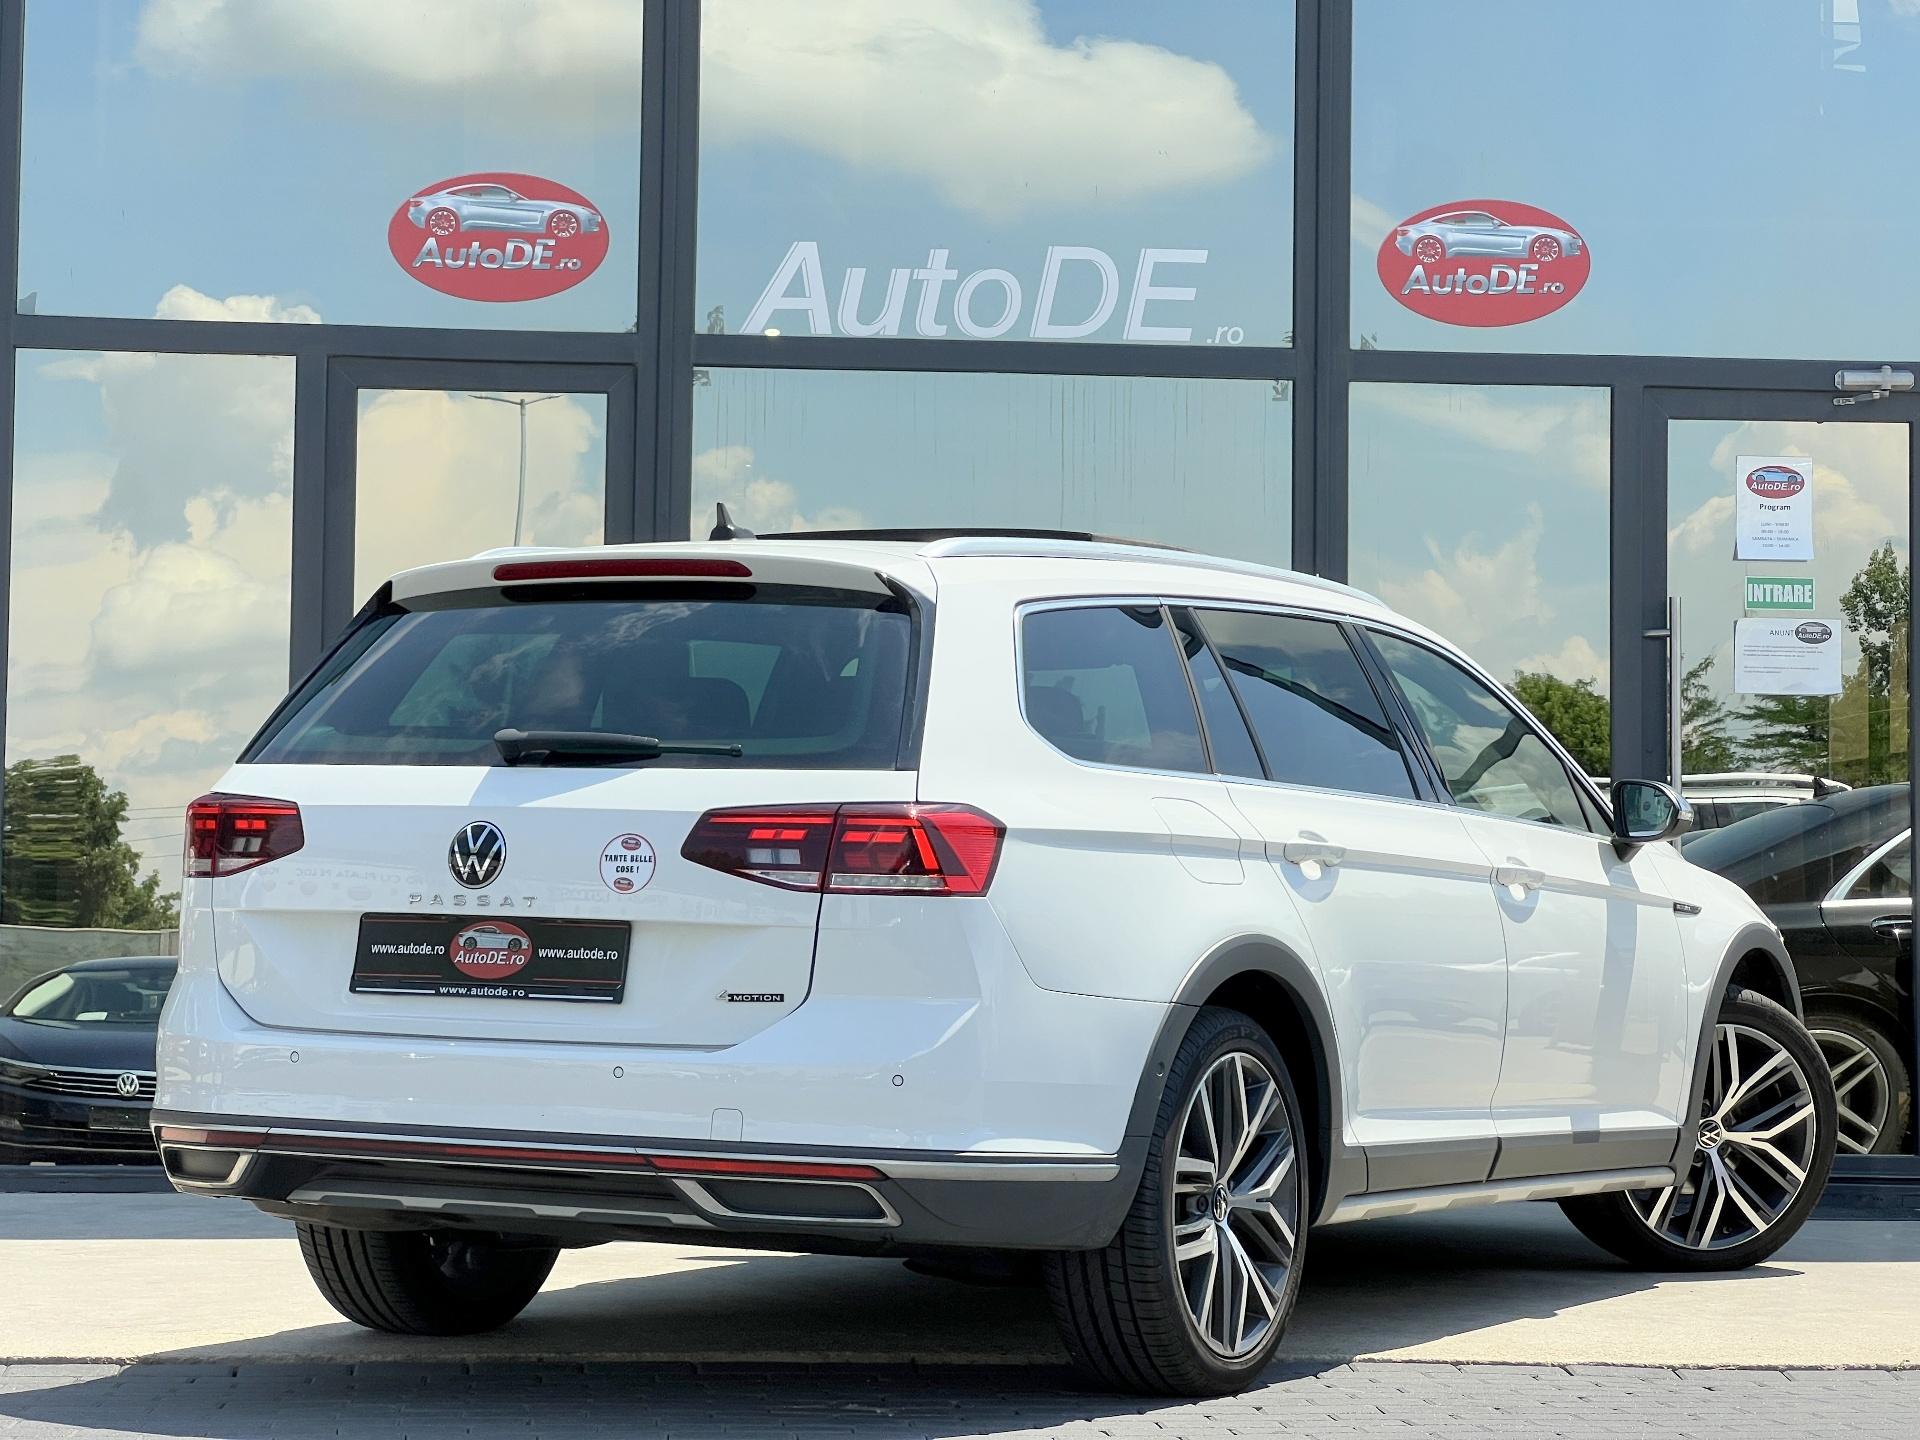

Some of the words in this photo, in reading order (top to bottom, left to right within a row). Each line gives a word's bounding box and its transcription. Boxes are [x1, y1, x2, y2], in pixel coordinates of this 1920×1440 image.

[1750, 481, 1801, 491] AutoDE.ro
[1759, 503, 1791, 511] Program
[1747, 583, 1812, 603] INTRARE
[604, 854, 628, 863] TANTE
[630, 855, 653, 863] BELLE
[615, 865, 635, 873] COSE
[409, 894, 538, 908] PASSAT
[371, 942, 445, 956] www.autode.ro
[538, 946, 619, 961] www.autode.ro
[454, 950, 526, 967] AutoDE.ro
[439, 984, 526, 998] www.autode.ro
